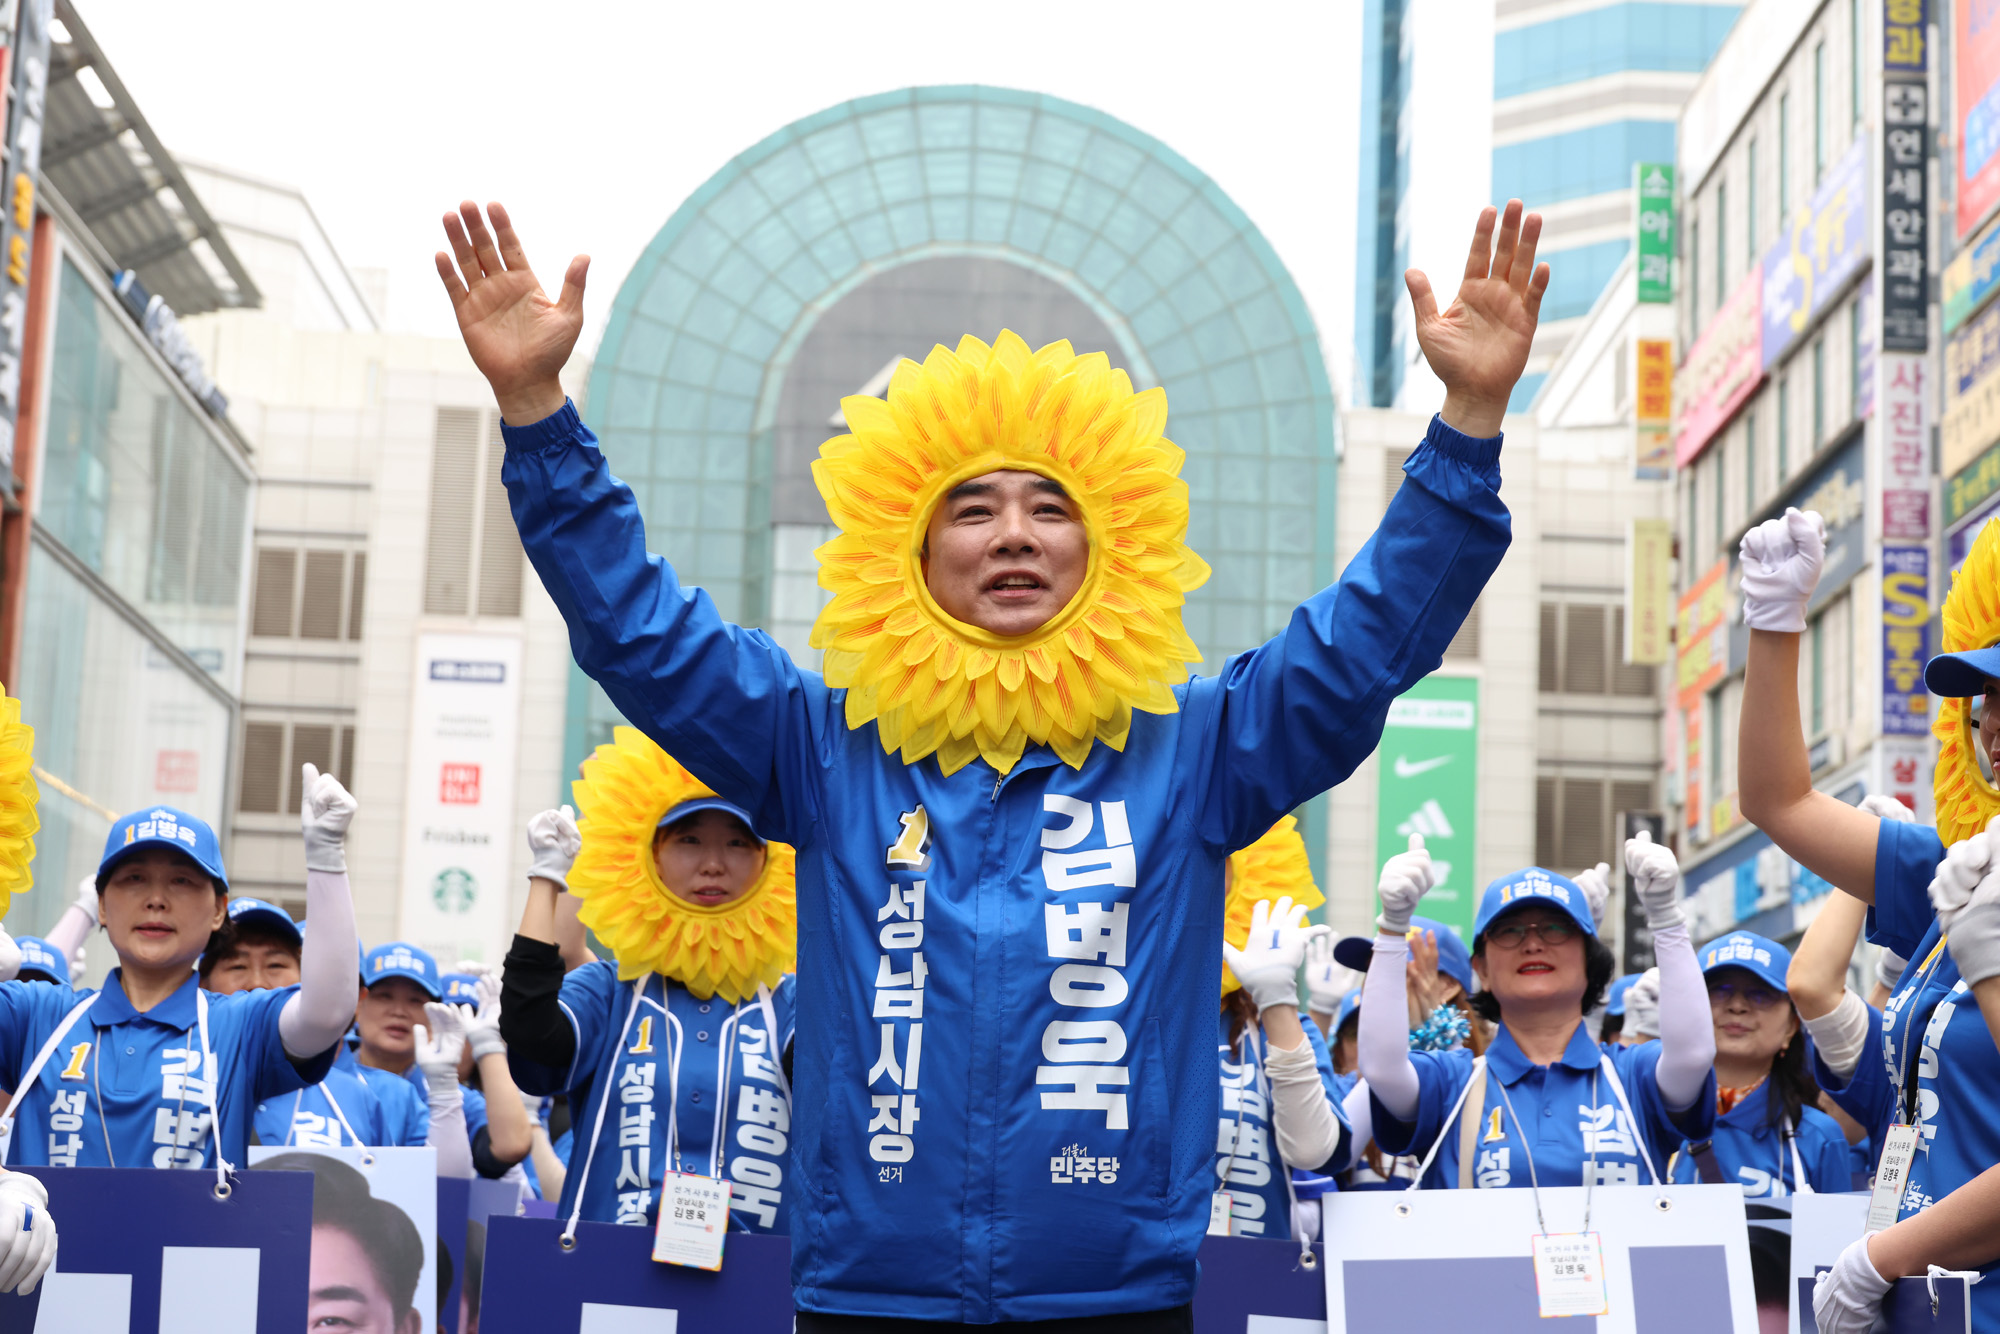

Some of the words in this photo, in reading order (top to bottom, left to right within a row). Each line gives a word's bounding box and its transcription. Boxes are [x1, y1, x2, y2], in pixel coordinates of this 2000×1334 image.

[1887, 130, 1924, 281] 연세안과
[1640, 166, 1671, 287] 소아과
[1890, 361, 1925, 477] 사진관
[138, 820, 196, 847] 김병욱
[886, 803, 932, 871] 1
[1514, 879, 1570, 904] 김병욱
[1036, 793, 1137, 1130] 김병욱
[1718, 944, 1771, 967] 김병욱
[628, 1016, 656, 1056] 1
[868, 880, 929, 1163] 성남시장
[60, 1042, 93, 1082] 1
[1483, 1105, 1507, 1145] 1
[1050, 1156, 1121, 1184] 민주당
[1061, 1142, 1088, 1158] 더불어
[878, 1166, 903, 1183] 선거
